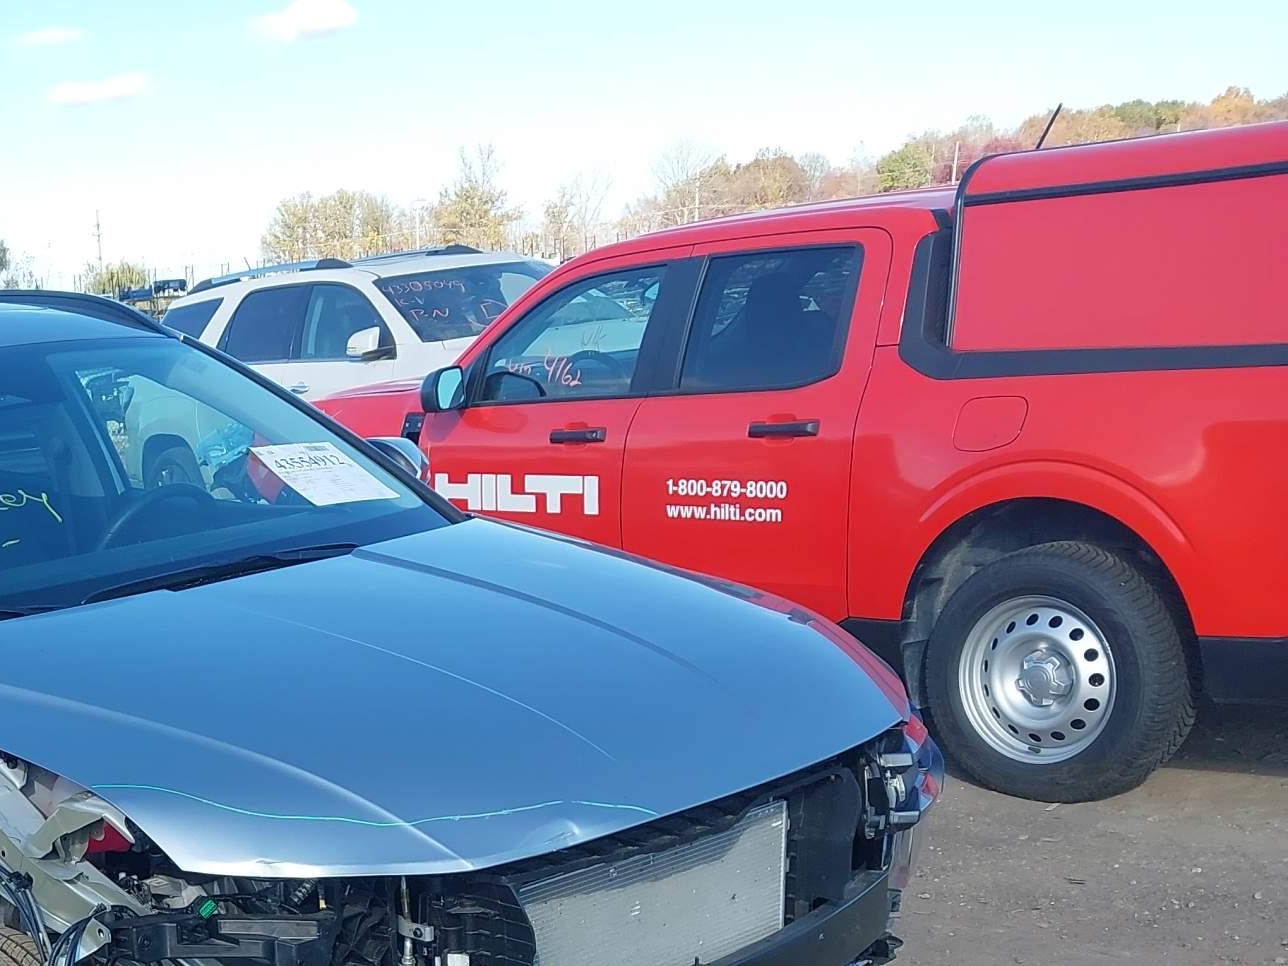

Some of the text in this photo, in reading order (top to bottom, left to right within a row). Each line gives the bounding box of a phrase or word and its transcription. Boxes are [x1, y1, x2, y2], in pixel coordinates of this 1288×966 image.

[274, 454, 345, 470] 43554912
[434, 473, 599, 515] HILTI
[666, 479, 787, 499] 1-800-879-8000
[666, 503, 782, 522] www.hilti.com
